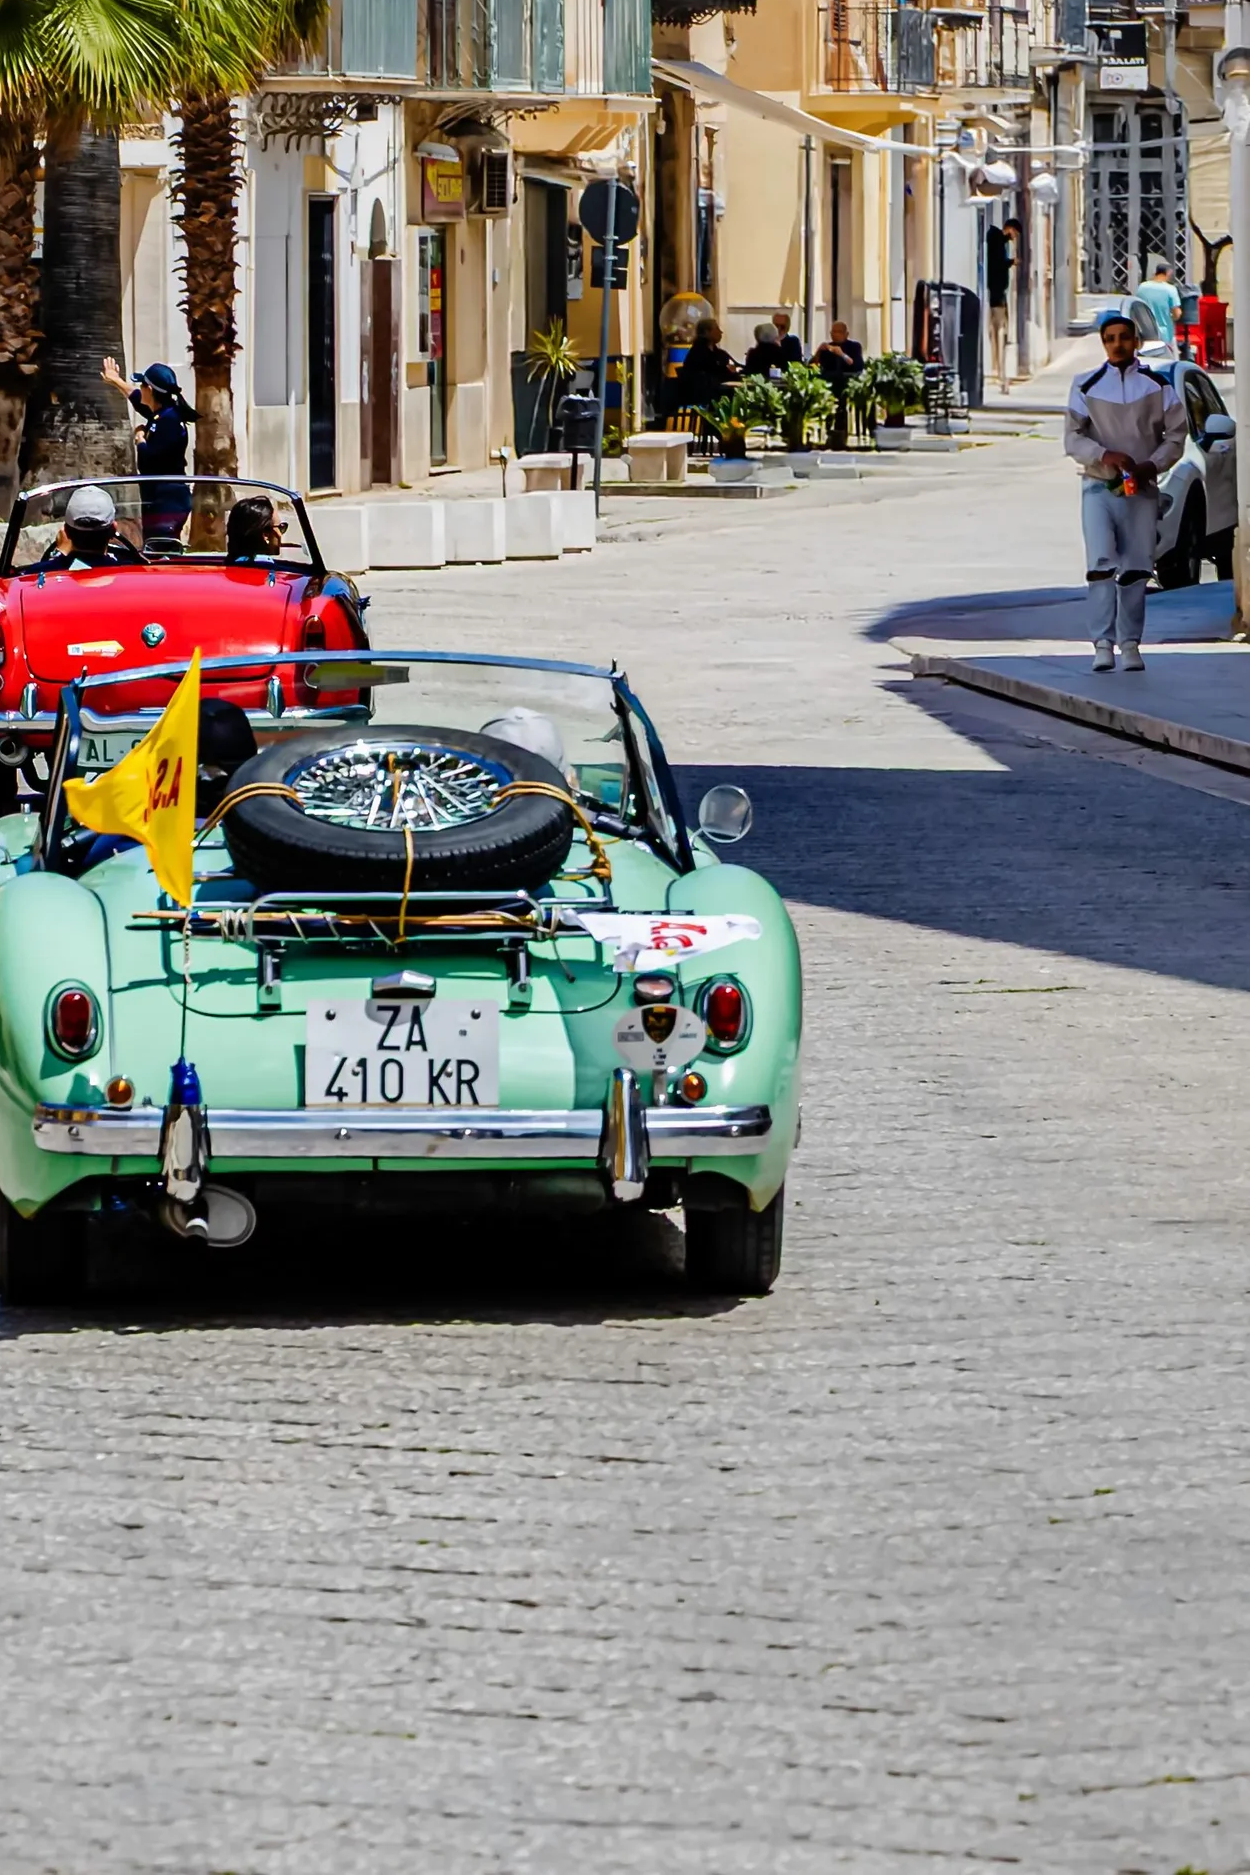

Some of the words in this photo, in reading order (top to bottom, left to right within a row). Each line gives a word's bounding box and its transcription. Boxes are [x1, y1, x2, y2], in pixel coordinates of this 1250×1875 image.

[376, 1004, 428, 1052] ZA
[324, 1057, 404, 1104] 410
[428, 1058, 480, 1105] KR
